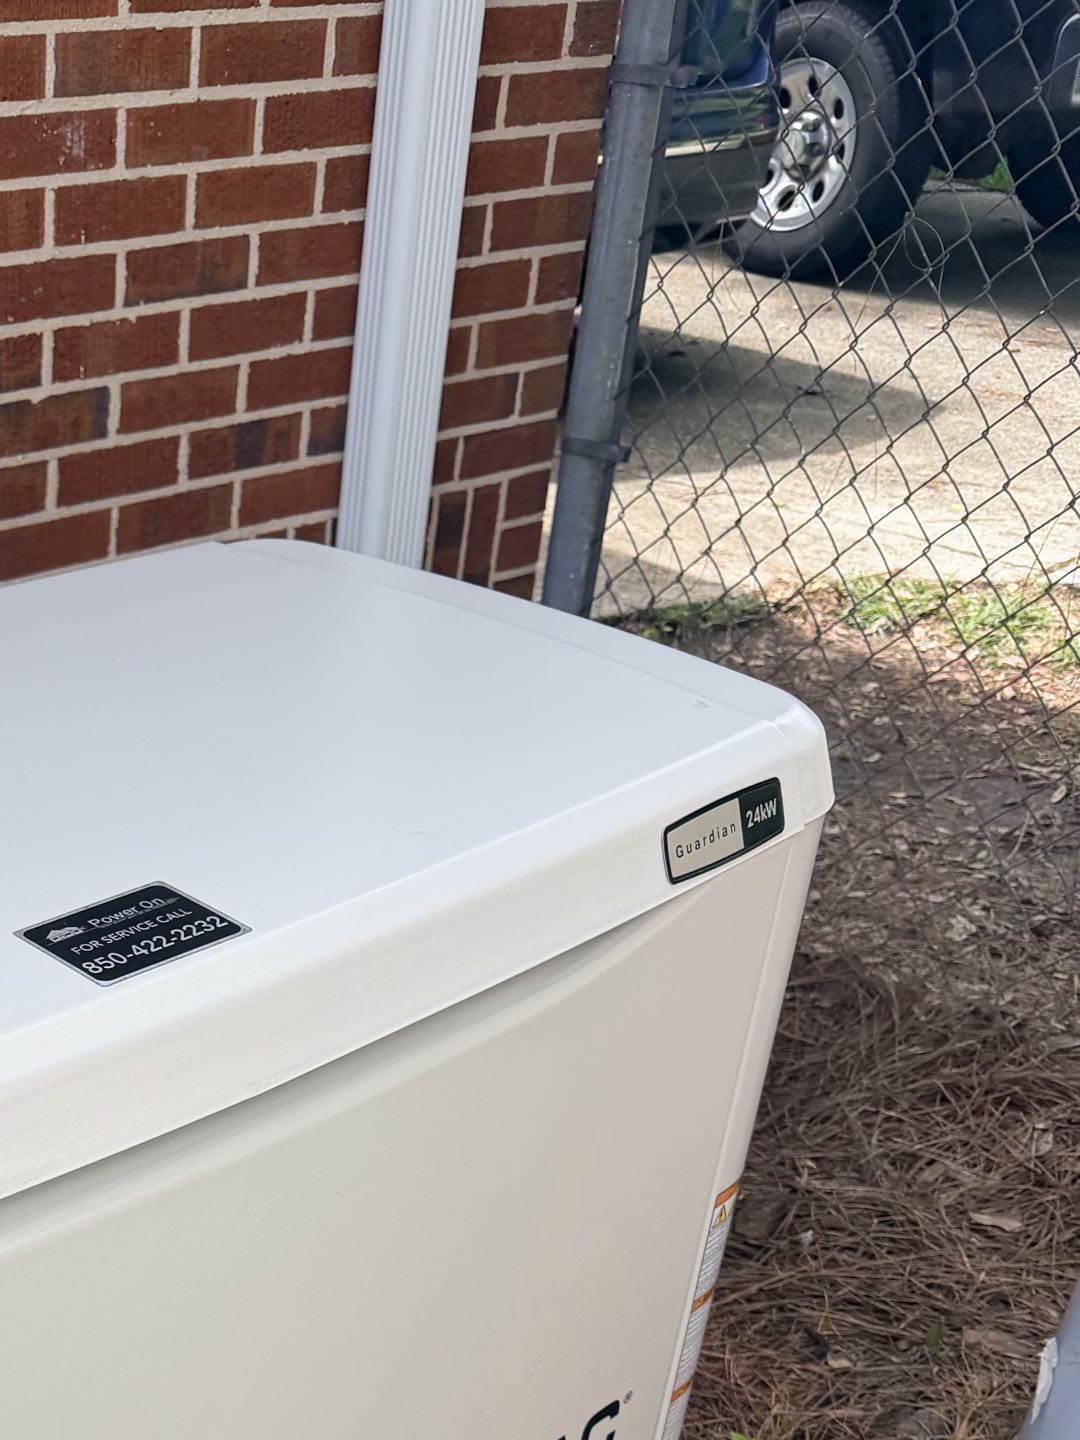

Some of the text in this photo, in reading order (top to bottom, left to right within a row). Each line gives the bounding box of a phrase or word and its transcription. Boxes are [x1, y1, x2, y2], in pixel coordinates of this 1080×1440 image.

[745, 797, 778, 829] 24kW
[675, 822, 737, 859] Guardian
[87, 904, 139, 928] Power
[139, 897, 165, 910] On
[70, 939, 103, 955] FOR
[103, 919, 159, 944] SERVICE
[158, 908, 193, 924] CALL
[82, 915, 229, 975] 850-422-2232
